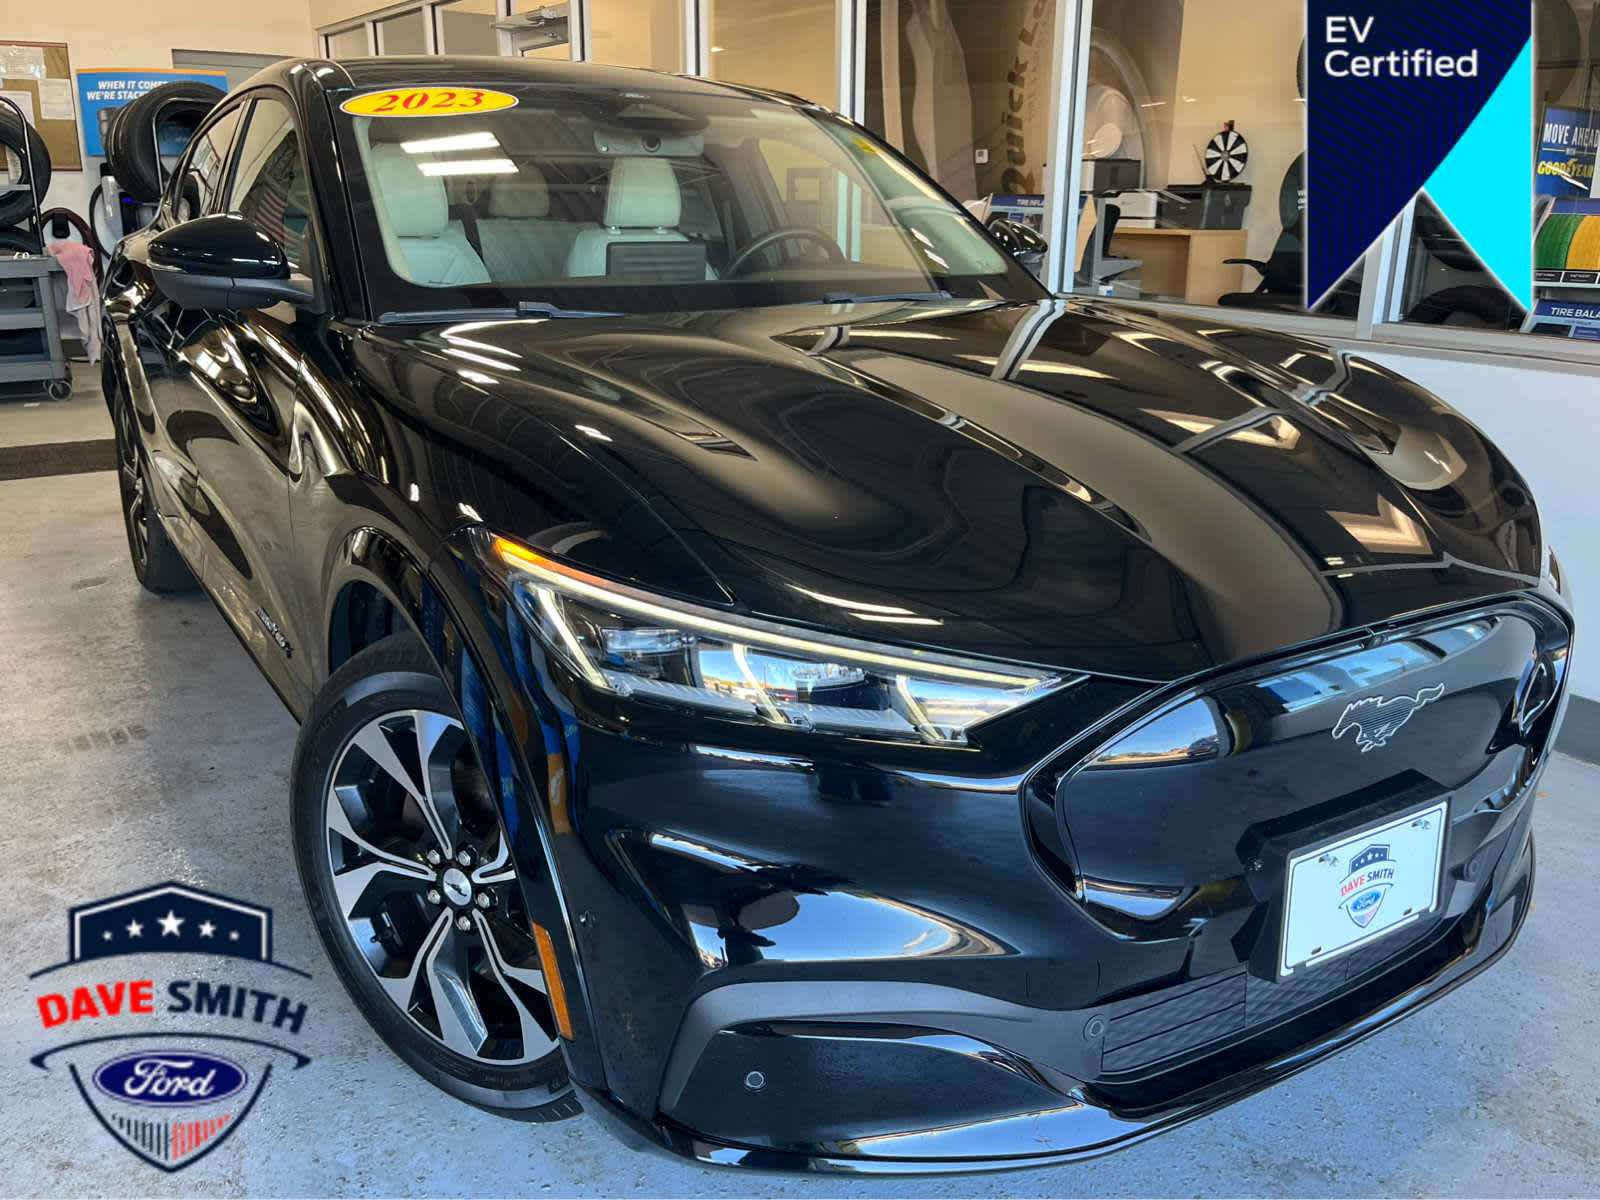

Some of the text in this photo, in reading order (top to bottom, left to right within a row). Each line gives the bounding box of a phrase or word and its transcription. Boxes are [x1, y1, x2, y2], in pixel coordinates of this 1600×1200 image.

[98, 80, 126, 90] WHEN
[127, 81, 136, 89] IT
[87, 91, 115, 100] WE'RE
[372, 91, 486, 113] 2023
[1543, 123, 1570, 145] MOVE
[1551, 307, 1574, 317] TIRE
[1341, 868, 1394, 897] DAVE SMITH
